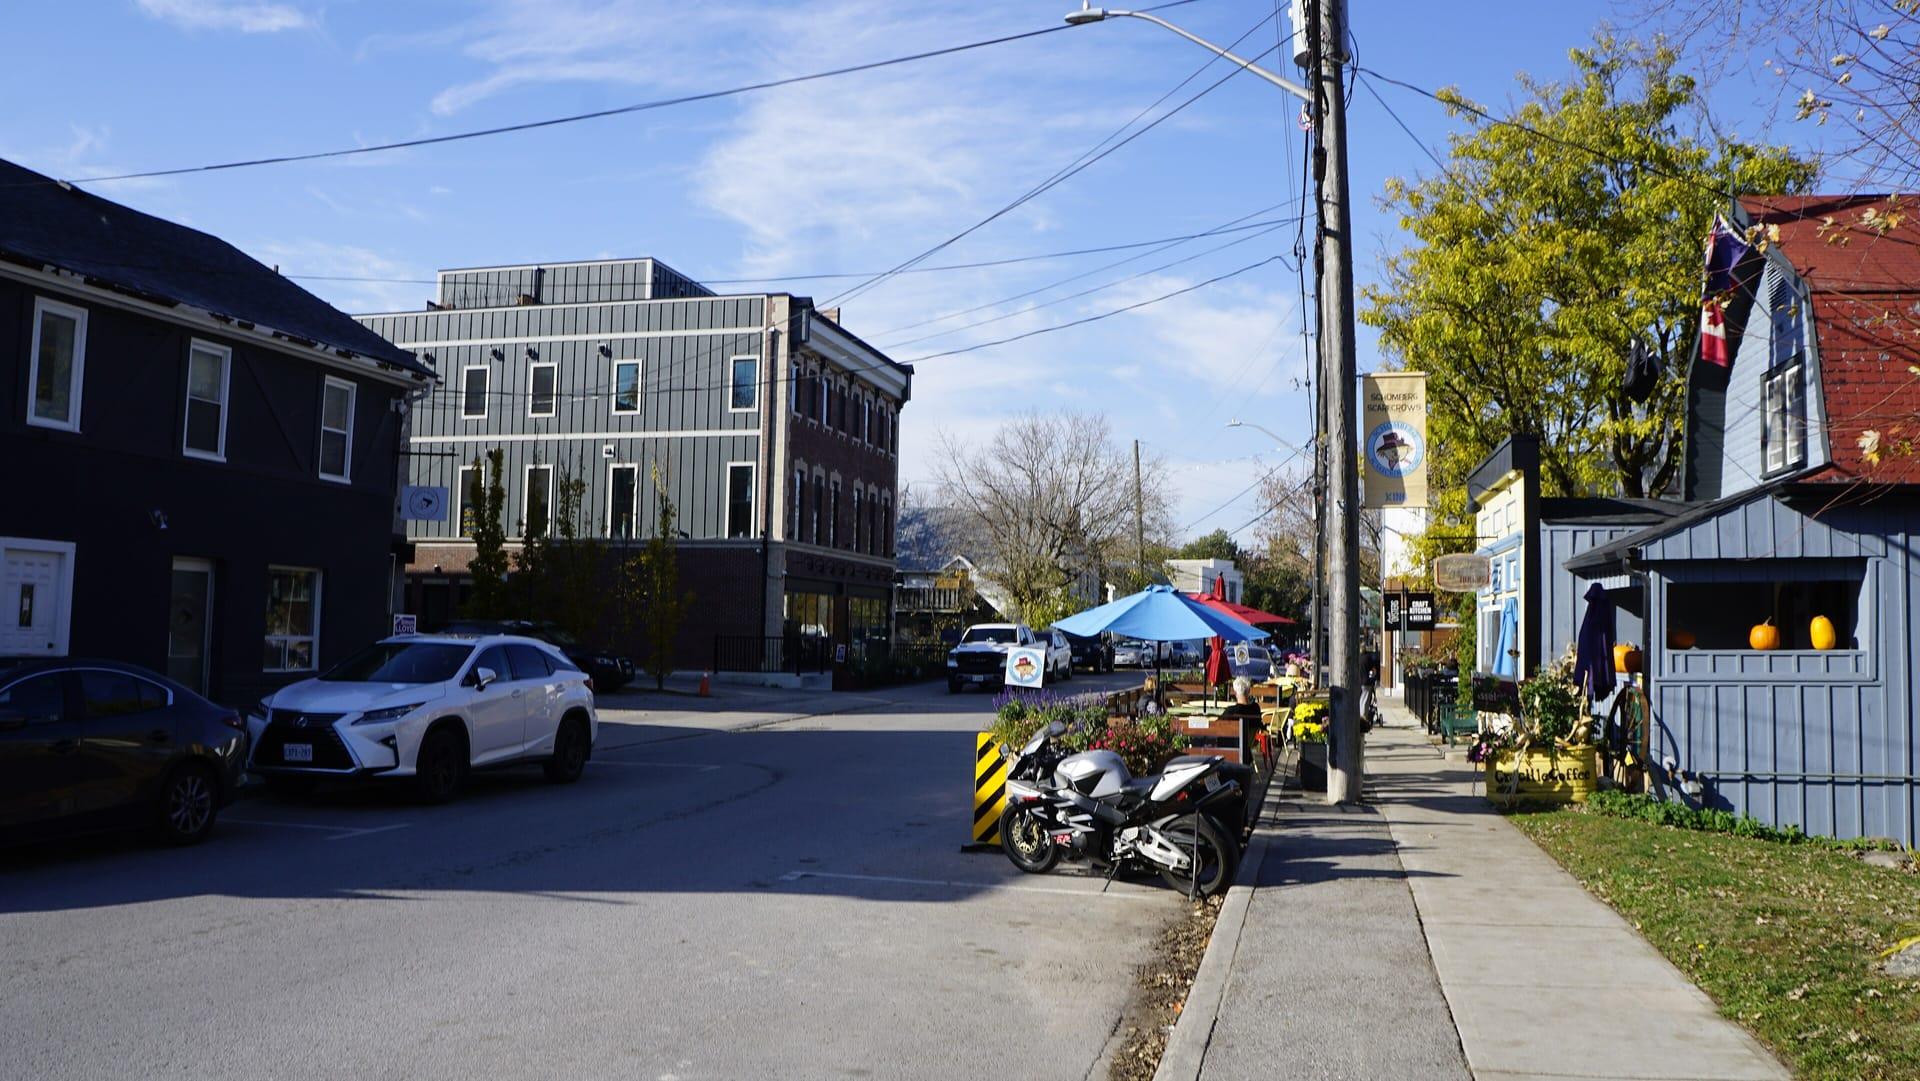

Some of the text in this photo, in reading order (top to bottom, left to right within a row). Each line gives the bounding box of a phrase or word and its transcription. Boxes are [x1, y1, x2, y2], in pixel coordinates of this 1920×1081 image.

[1370, 392, 1418, 401] SCHOMBERG
[1367, 403, 1422, 412] SCARECROWS
[1411, 600, 1429, 608] CRAFT
[1495, 768, 1548, 783] Grckle
